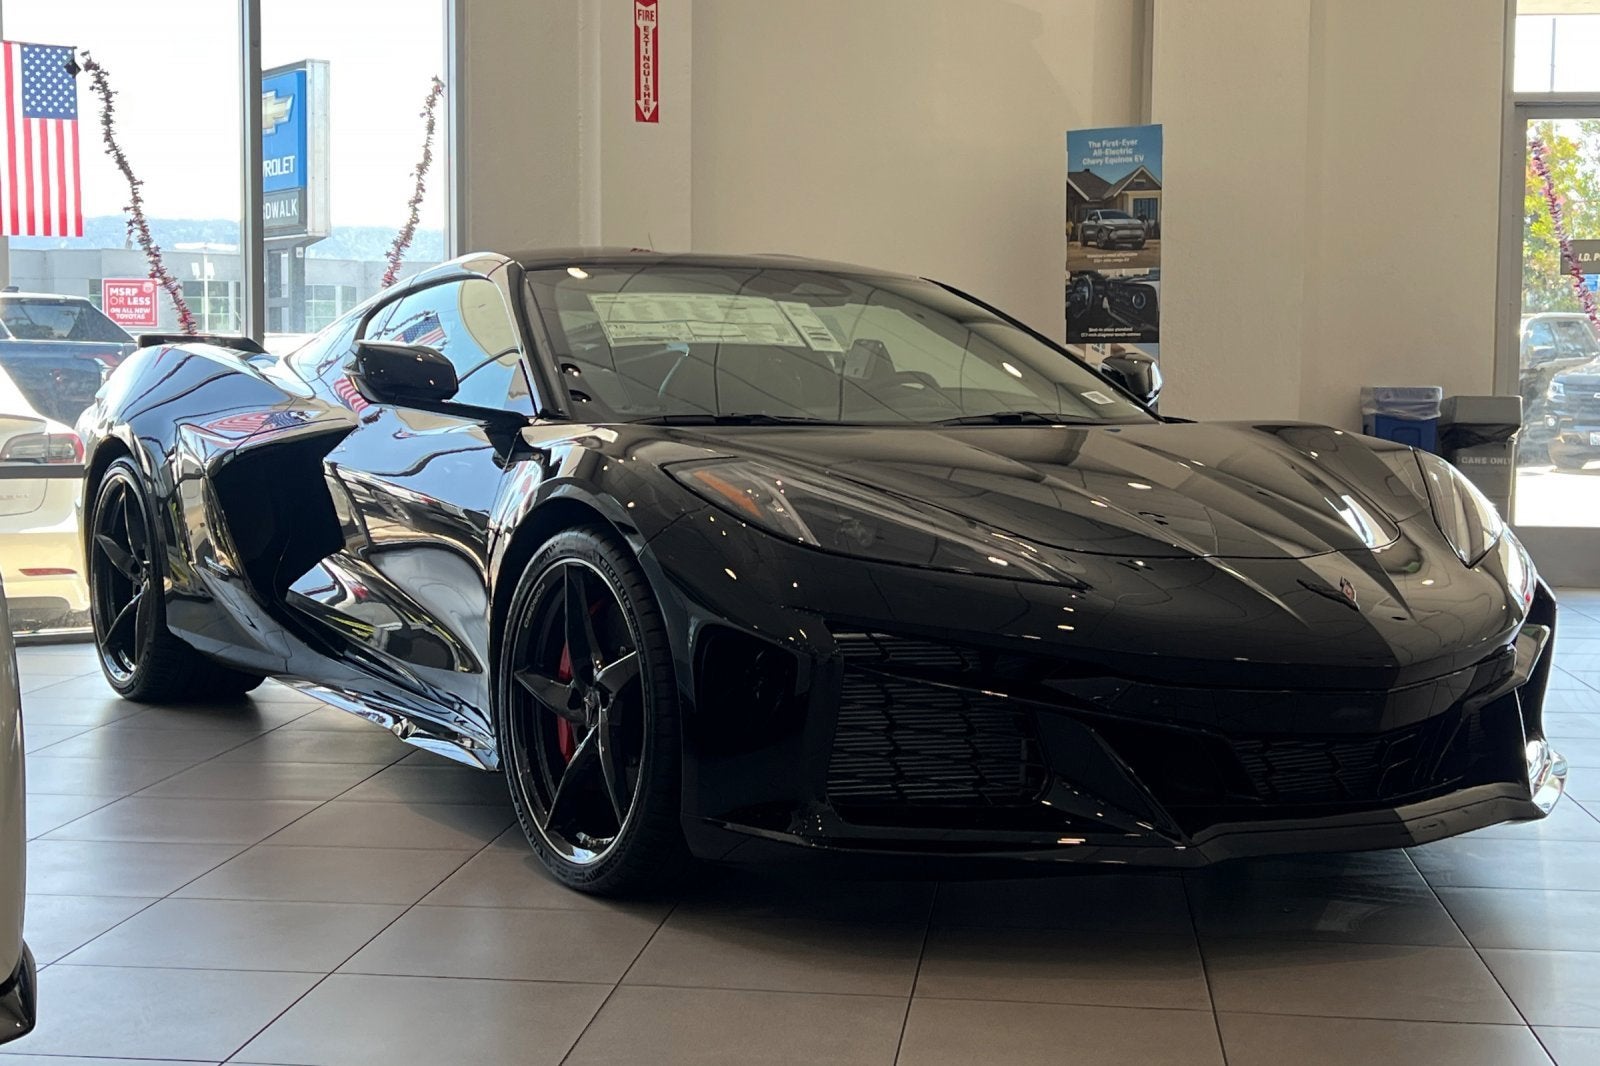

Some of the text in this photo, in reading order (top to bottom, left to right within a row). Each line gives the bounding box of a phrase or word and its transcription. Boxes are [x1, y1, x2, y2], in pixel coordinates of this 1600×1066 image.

[638, 9, 655, 21] FIRE
[1102, 139, 1138, 147] First-Ever
[1093, 148, 1133, 156] All-Electric
[1105, 156, 1132, 164] Equinox
[1135, 155, 1144, 163] EV
[263, 198, 298, 219] DWALK
[110, 287, 138, 296] MSRP
[110, 297, 151, 305] OR LESS
